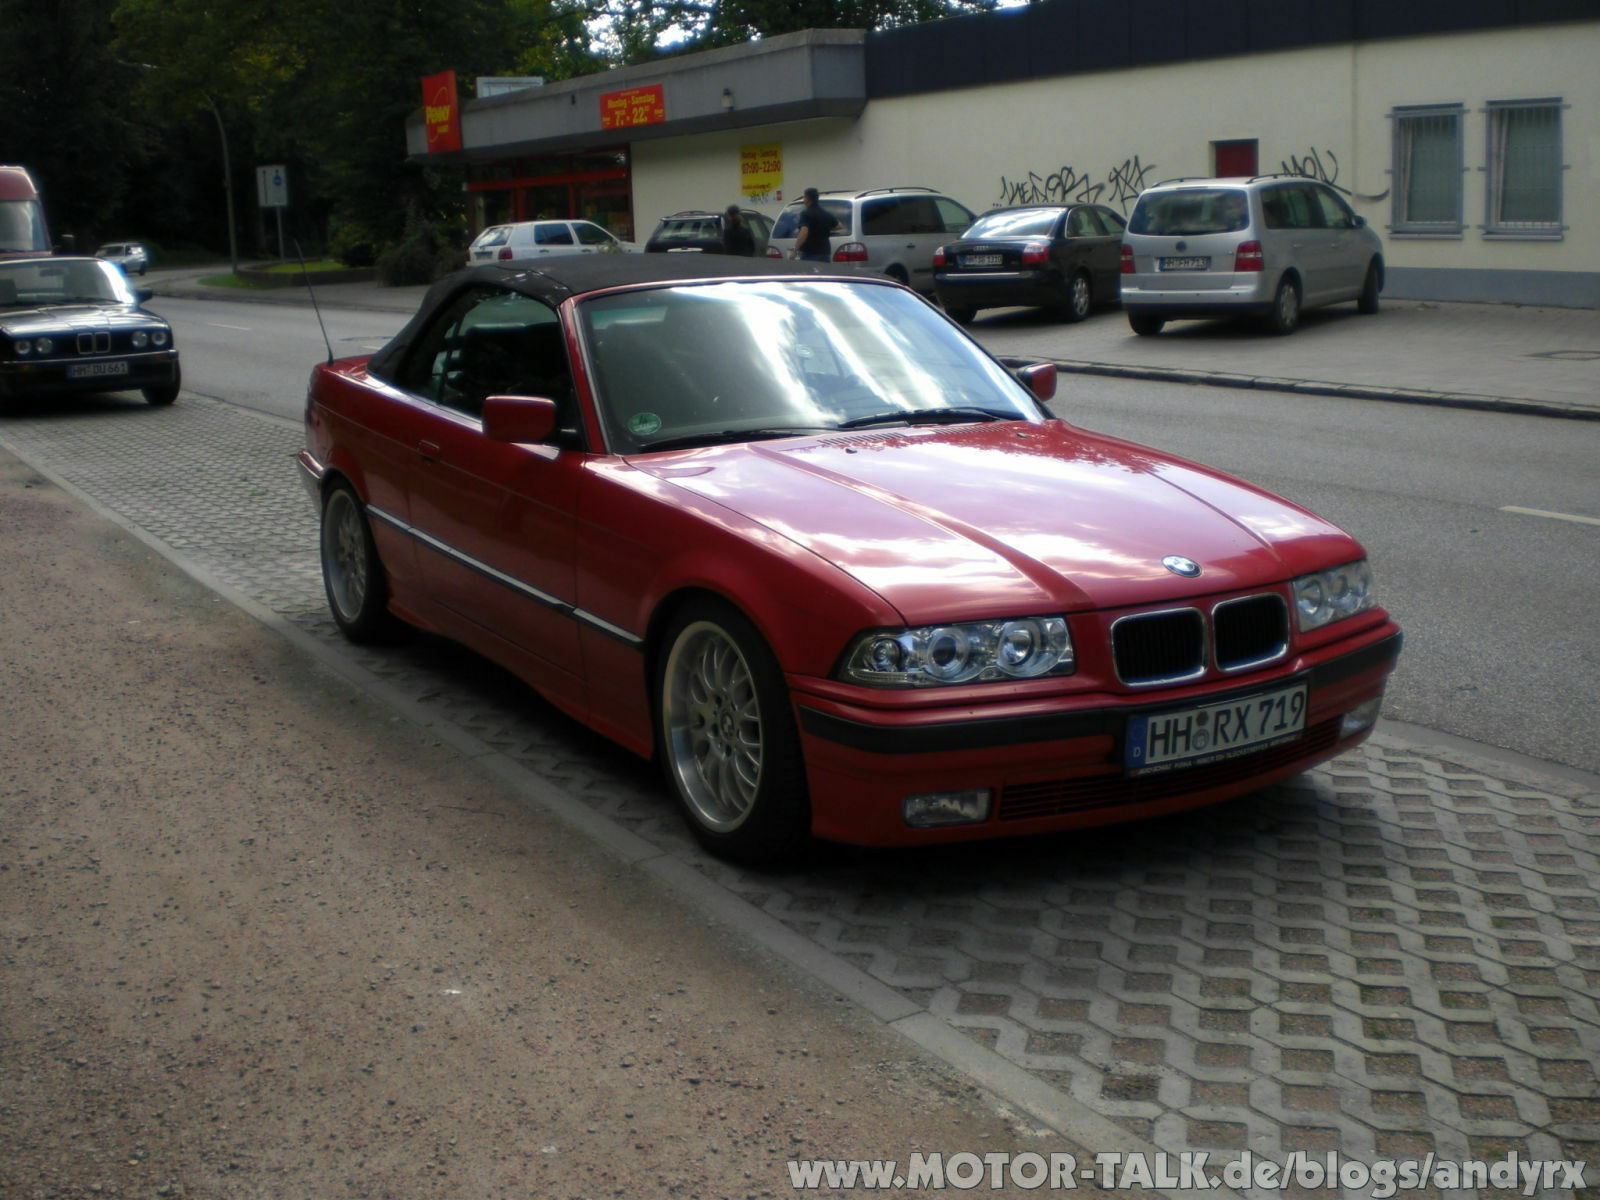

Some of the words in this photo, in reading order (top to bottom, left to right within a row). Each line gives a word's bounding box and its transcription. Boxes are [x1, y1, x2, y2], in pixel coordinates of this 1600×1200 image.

[1213, 704, 1251, 746] RX
[1259, 691, 1305, 735] 719
[1133, 747, 1141, 758] D
